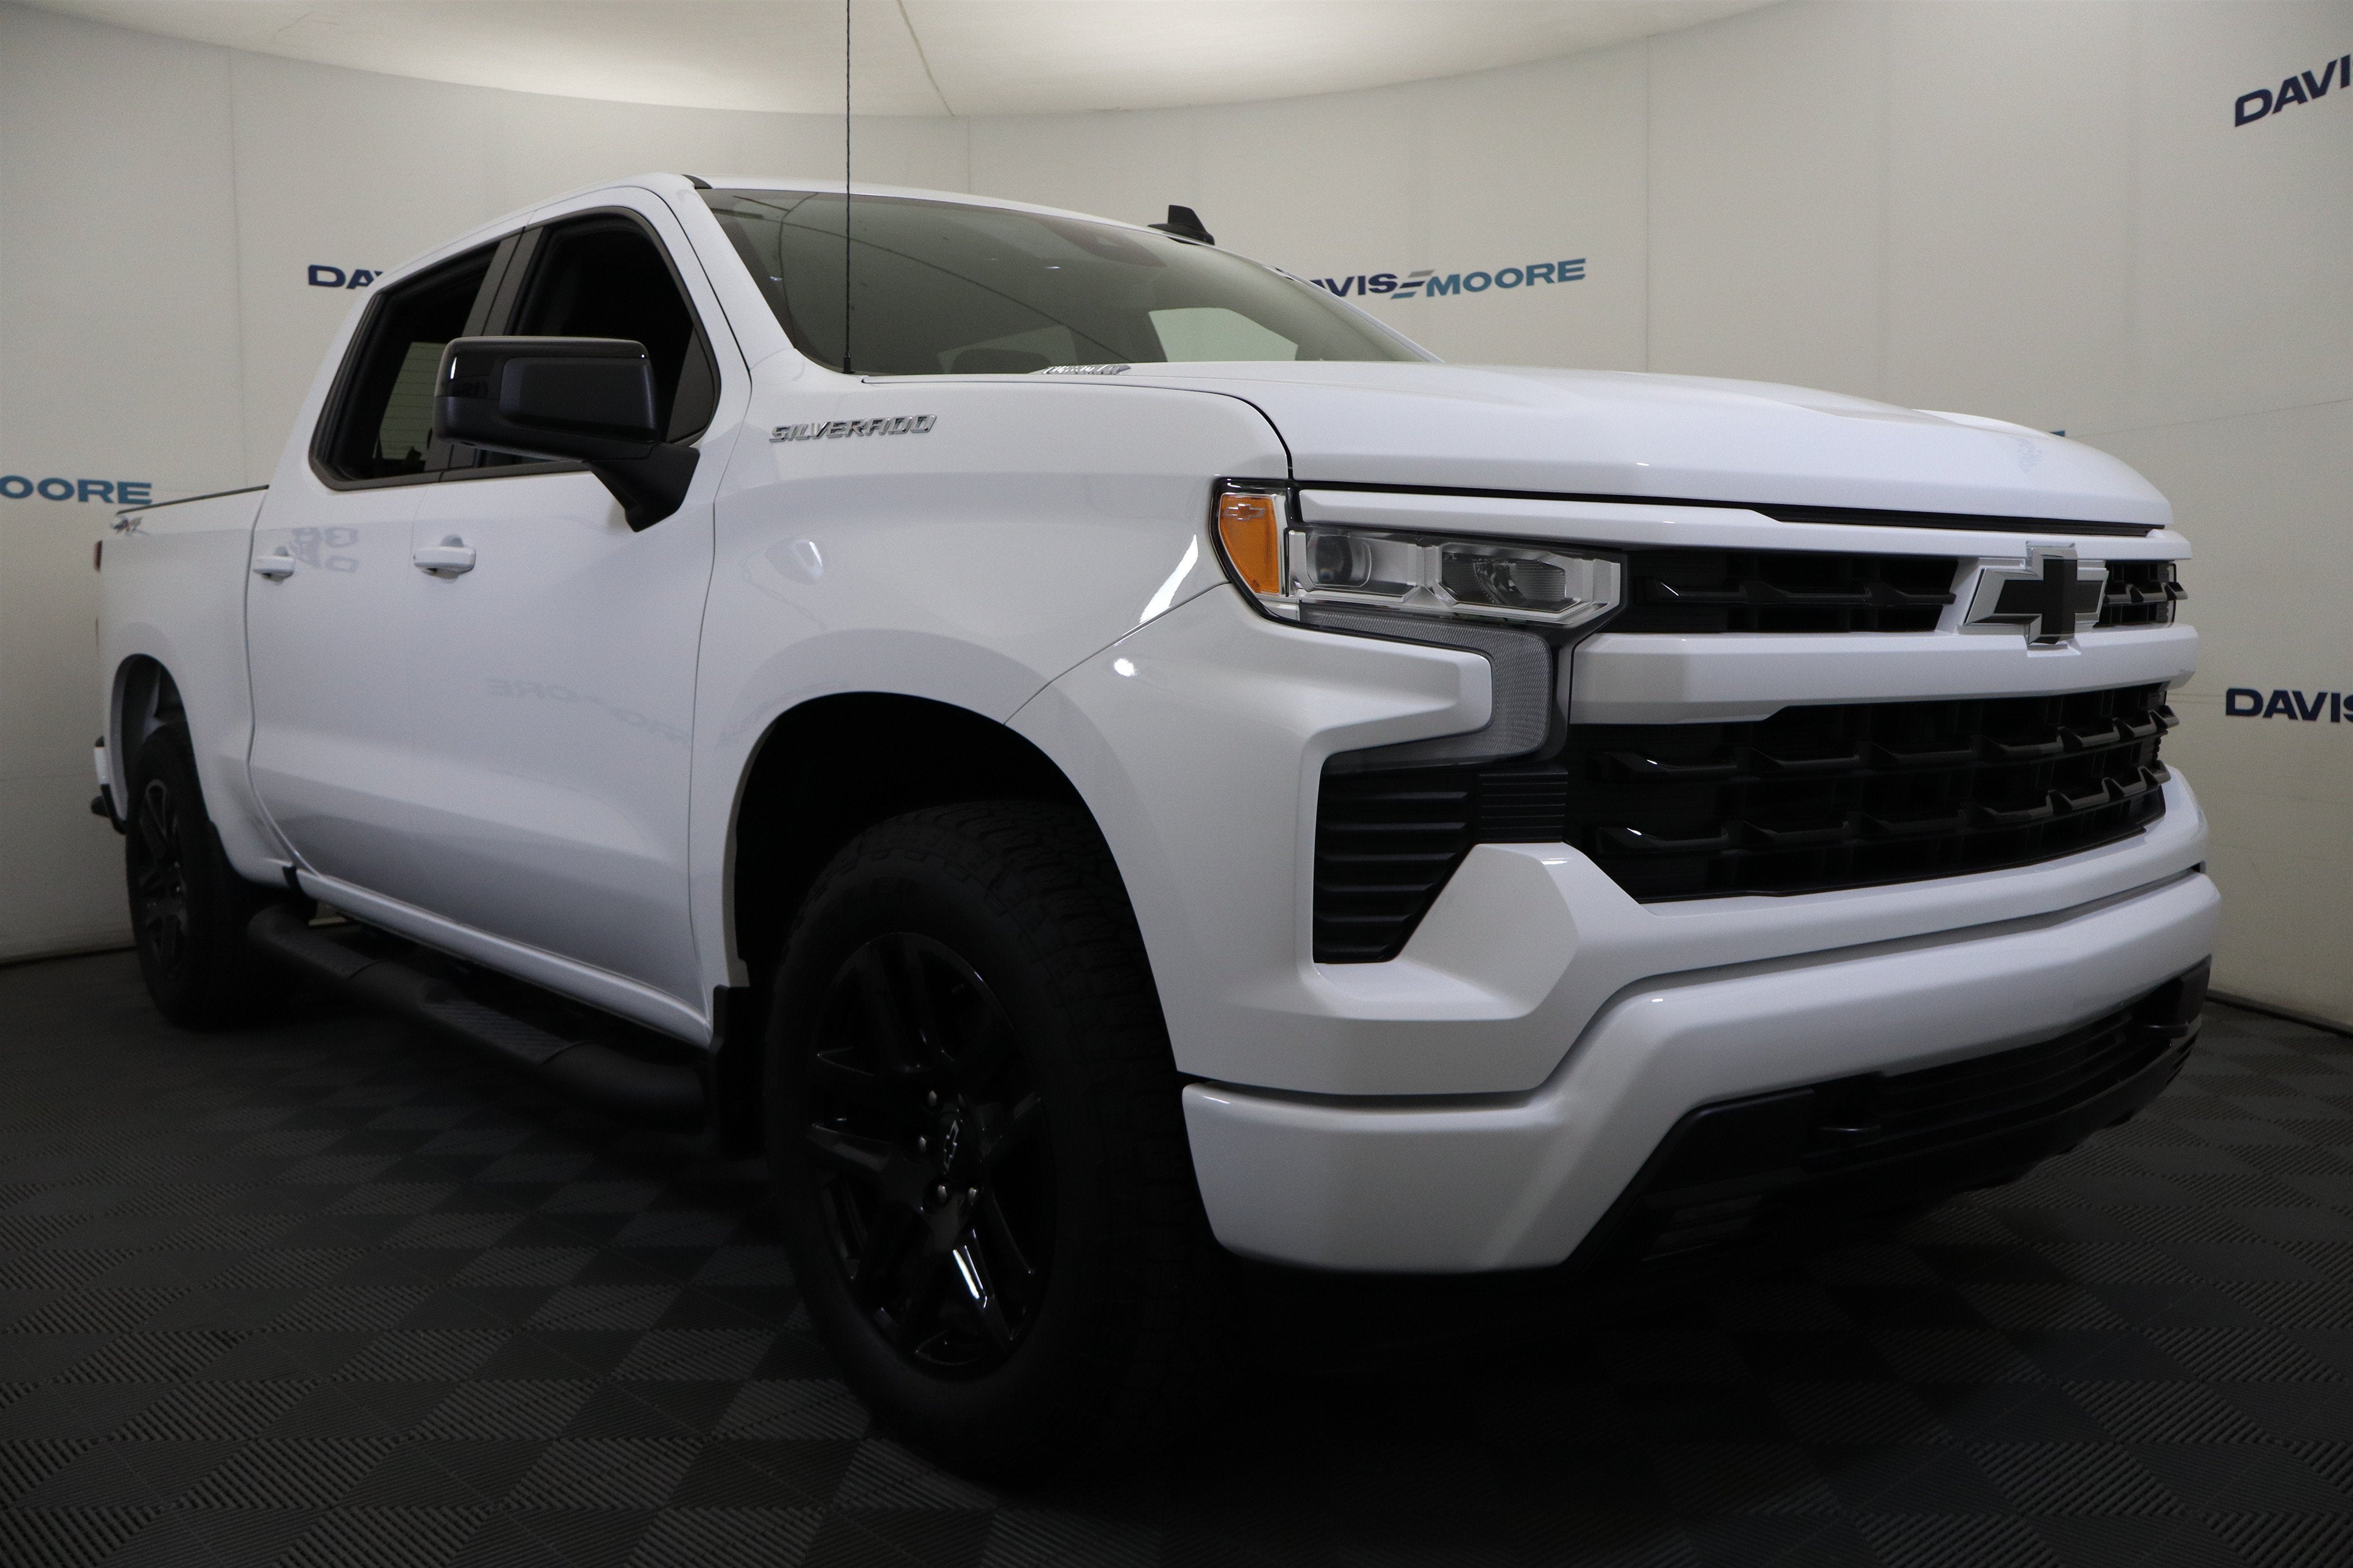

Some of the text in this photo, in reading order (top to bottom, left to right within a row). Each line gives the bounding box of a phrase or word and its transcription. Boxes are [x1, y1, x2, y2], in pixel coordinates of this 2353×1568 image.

[2235, 54, 2353, 126] DAVI
[308, 264, 383, 289] DA
[1426, 258, 1586, 297] MOORE
[769, 414, 938, 443] SILVERADO
[2225, 688, 2353, 723] DAVI
